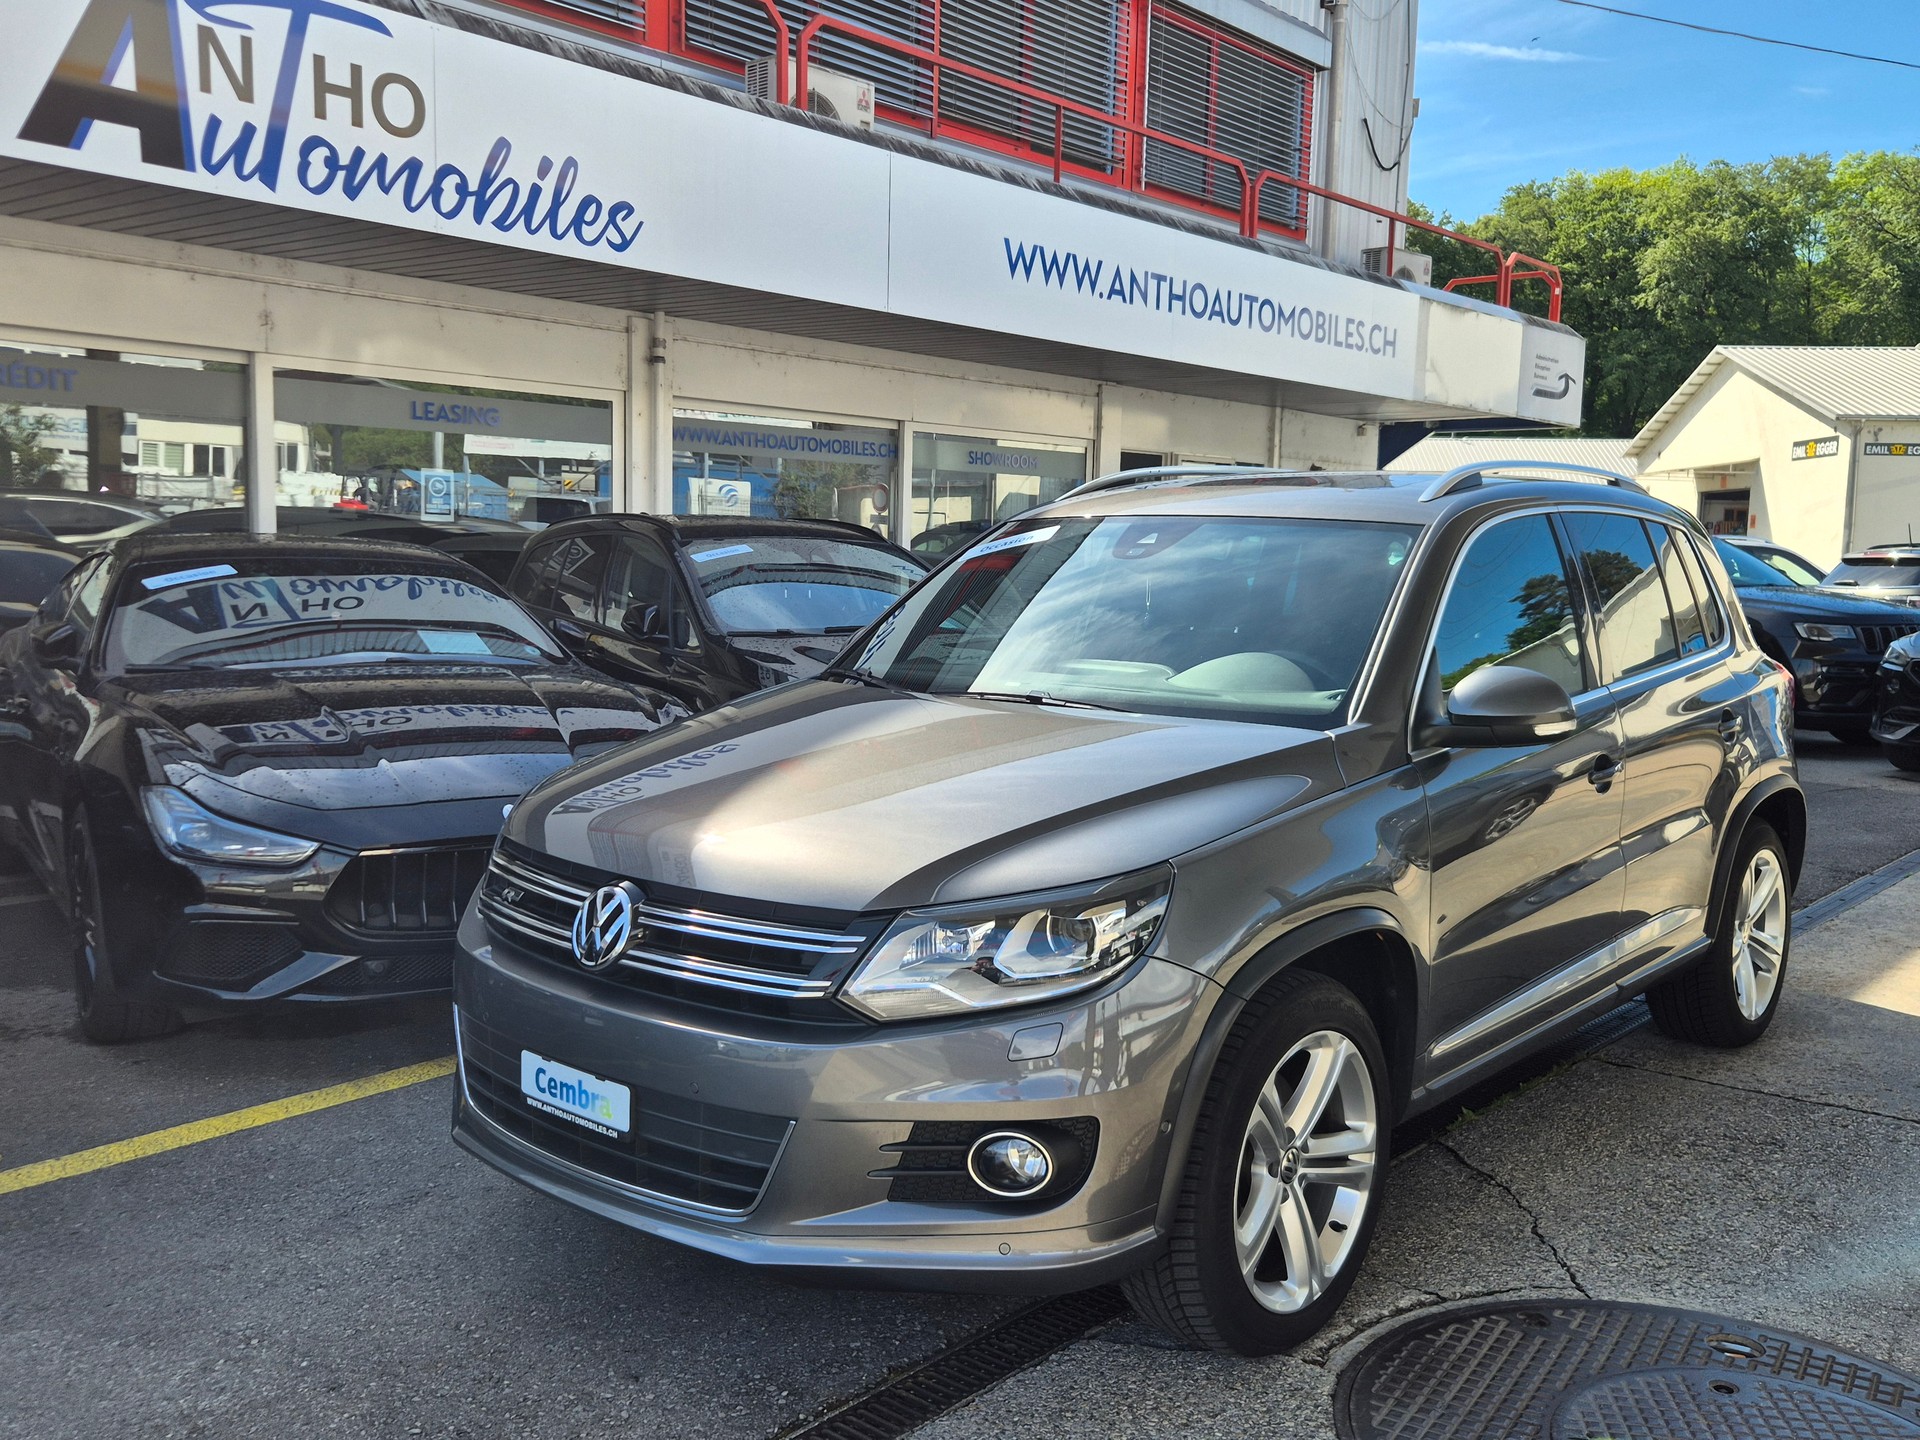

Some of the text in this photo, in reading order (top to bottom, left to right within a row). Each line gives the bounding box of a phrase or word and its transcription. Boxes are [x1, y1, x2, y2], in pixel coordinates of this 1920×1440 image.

[1003, 237, 1398, 358] WWW.ANTHOAUTOMOBILES.CH
[411, 400, 500, 427] LEASING
[672, 426, 898, 460] WWW.ANTHOAUTOMOBILES.CH
[1816, 441, 1838, 456] EGGER
[1866, 445, 1890, 455] EMIL
[968, 450, 1038, 470] SHOWROOM
[534, 1066, 614, 1120] Cembra
[526, 1096, 618, 1139] WWW.ANTHOAUTOMOBILES.CH
